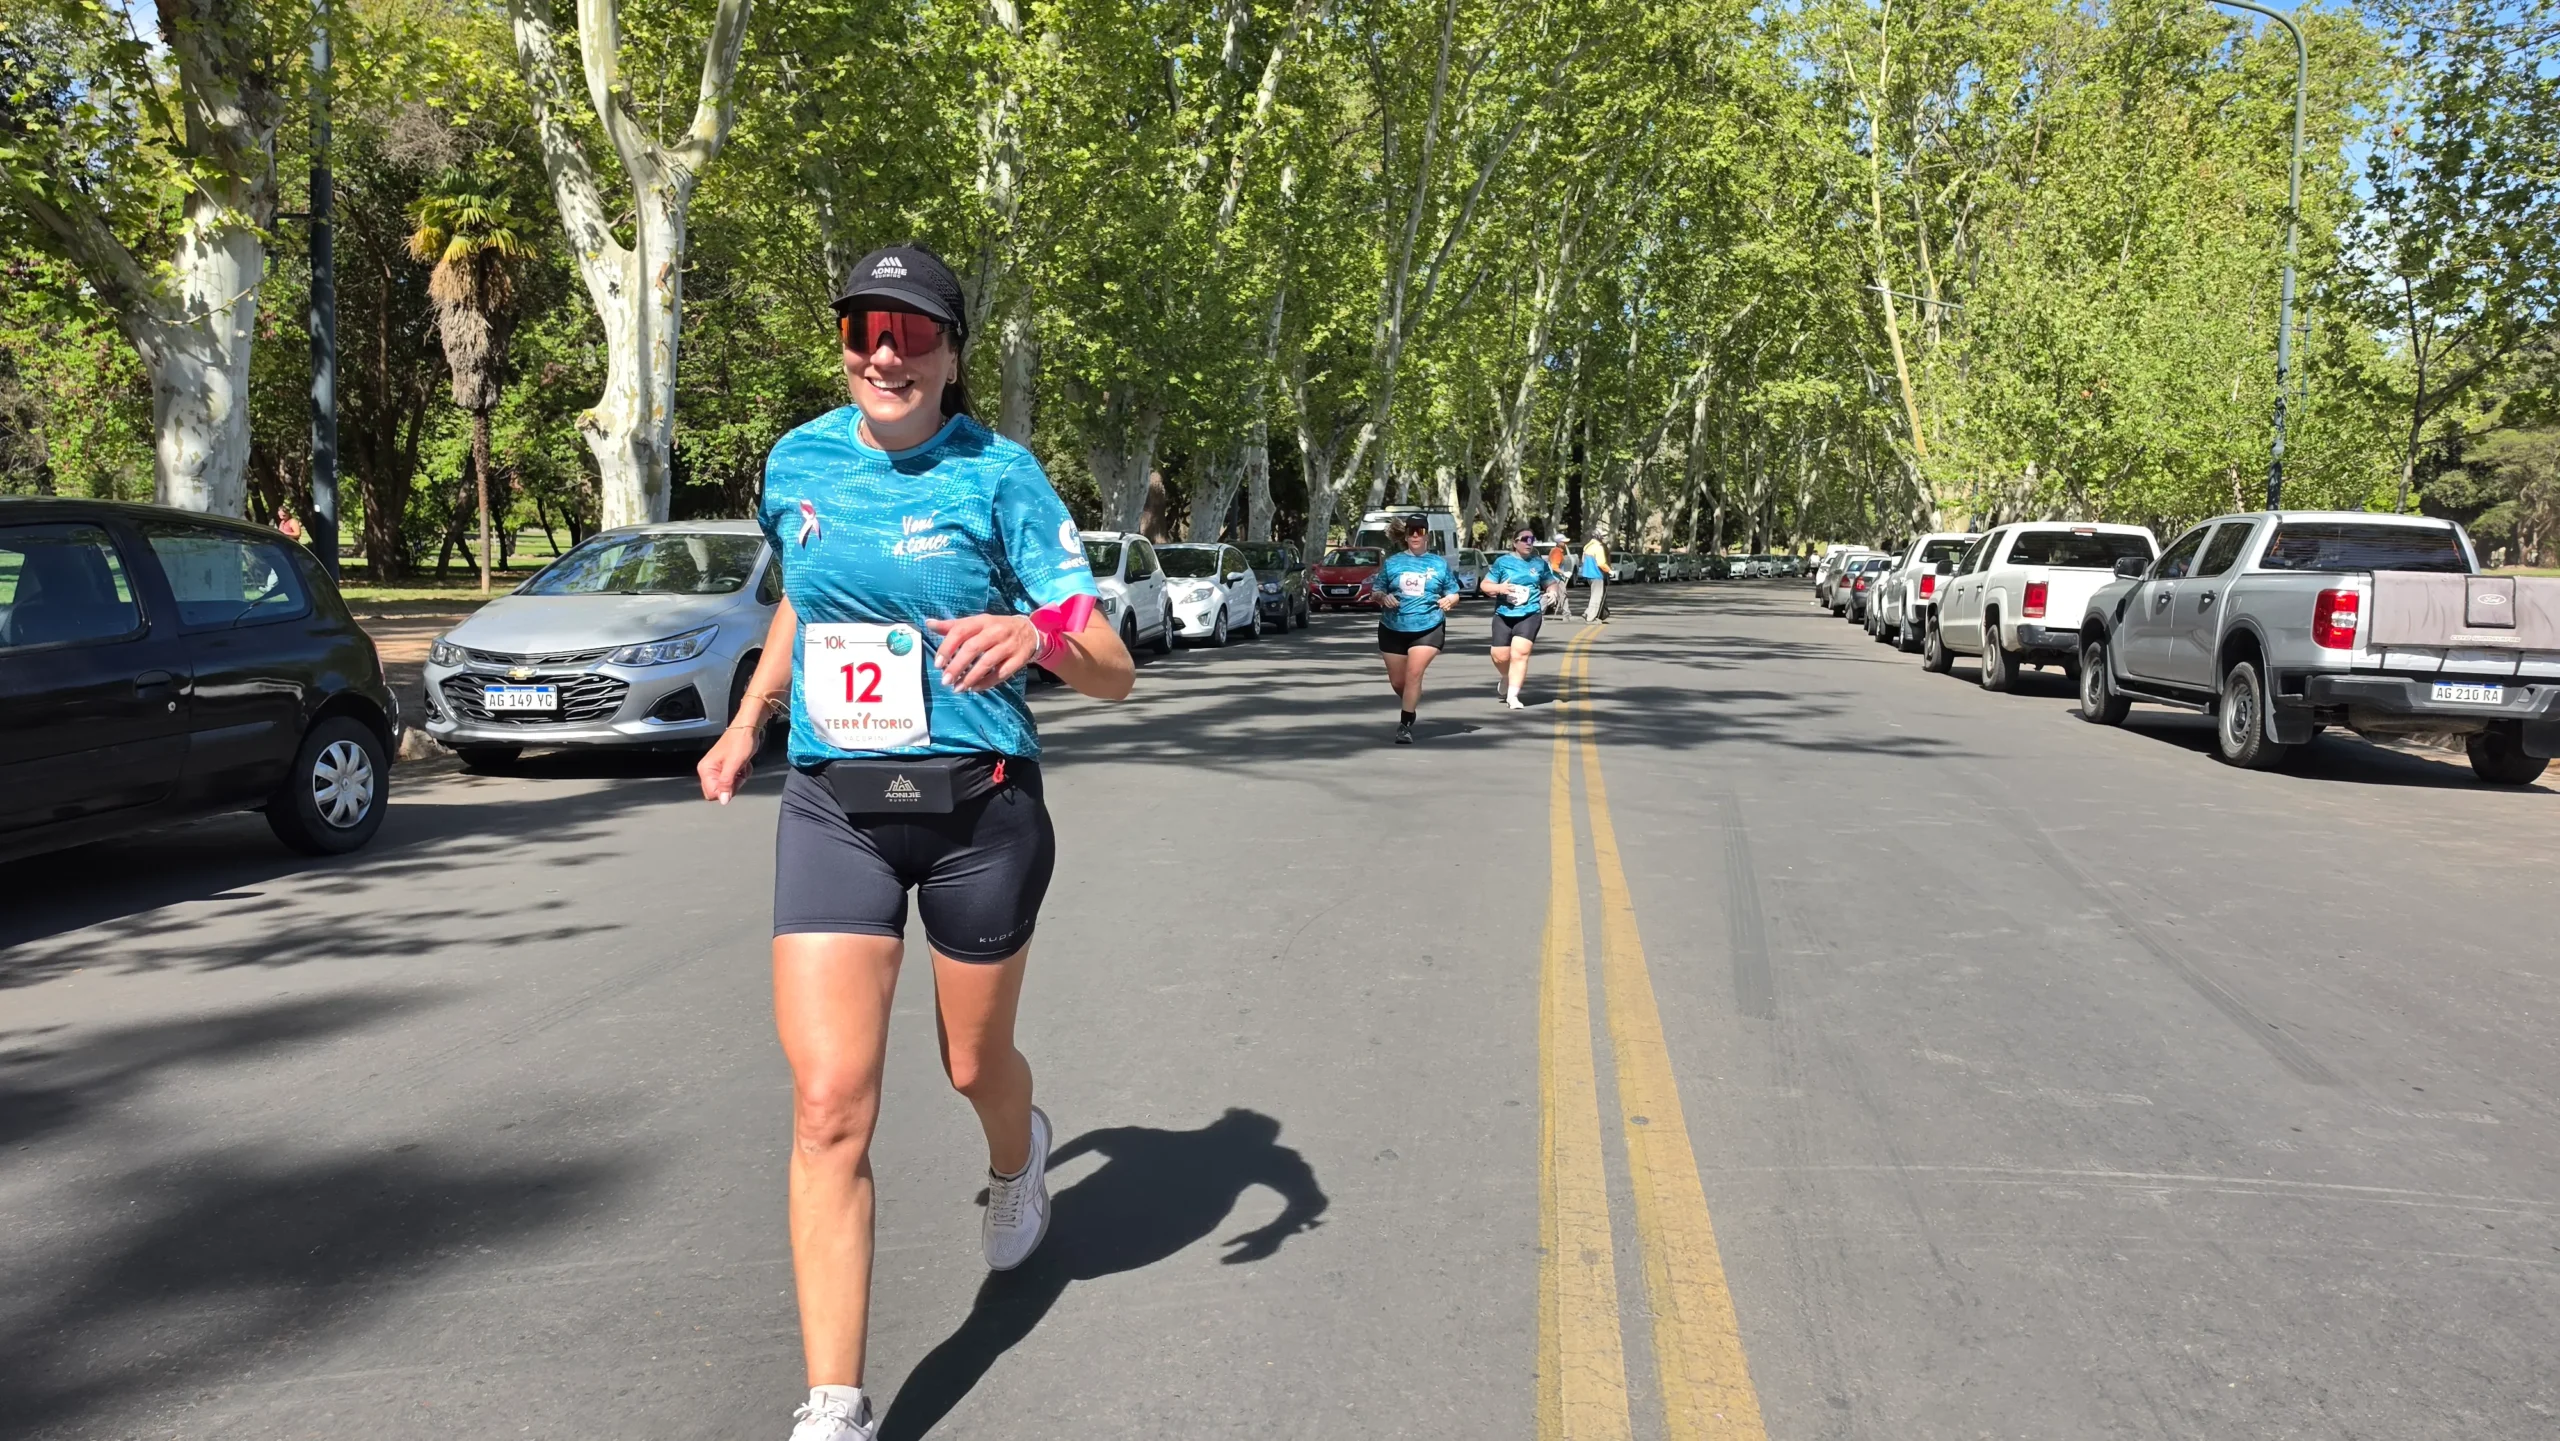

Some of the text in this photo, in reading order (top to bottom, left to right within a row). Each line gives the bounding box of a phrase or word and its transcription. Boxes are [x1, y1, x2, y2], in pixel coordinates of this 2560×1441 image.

[871, 267, 908, 276] AONIJIE
[1405, 578, 1419, 587] 64
[824, 635, 846, 650] 10k
[840, 661, 883, 703] 12
[489, 694, 553, 707] AG 149 YC
[2436, 687, 2499, 702] AG 210 RA
